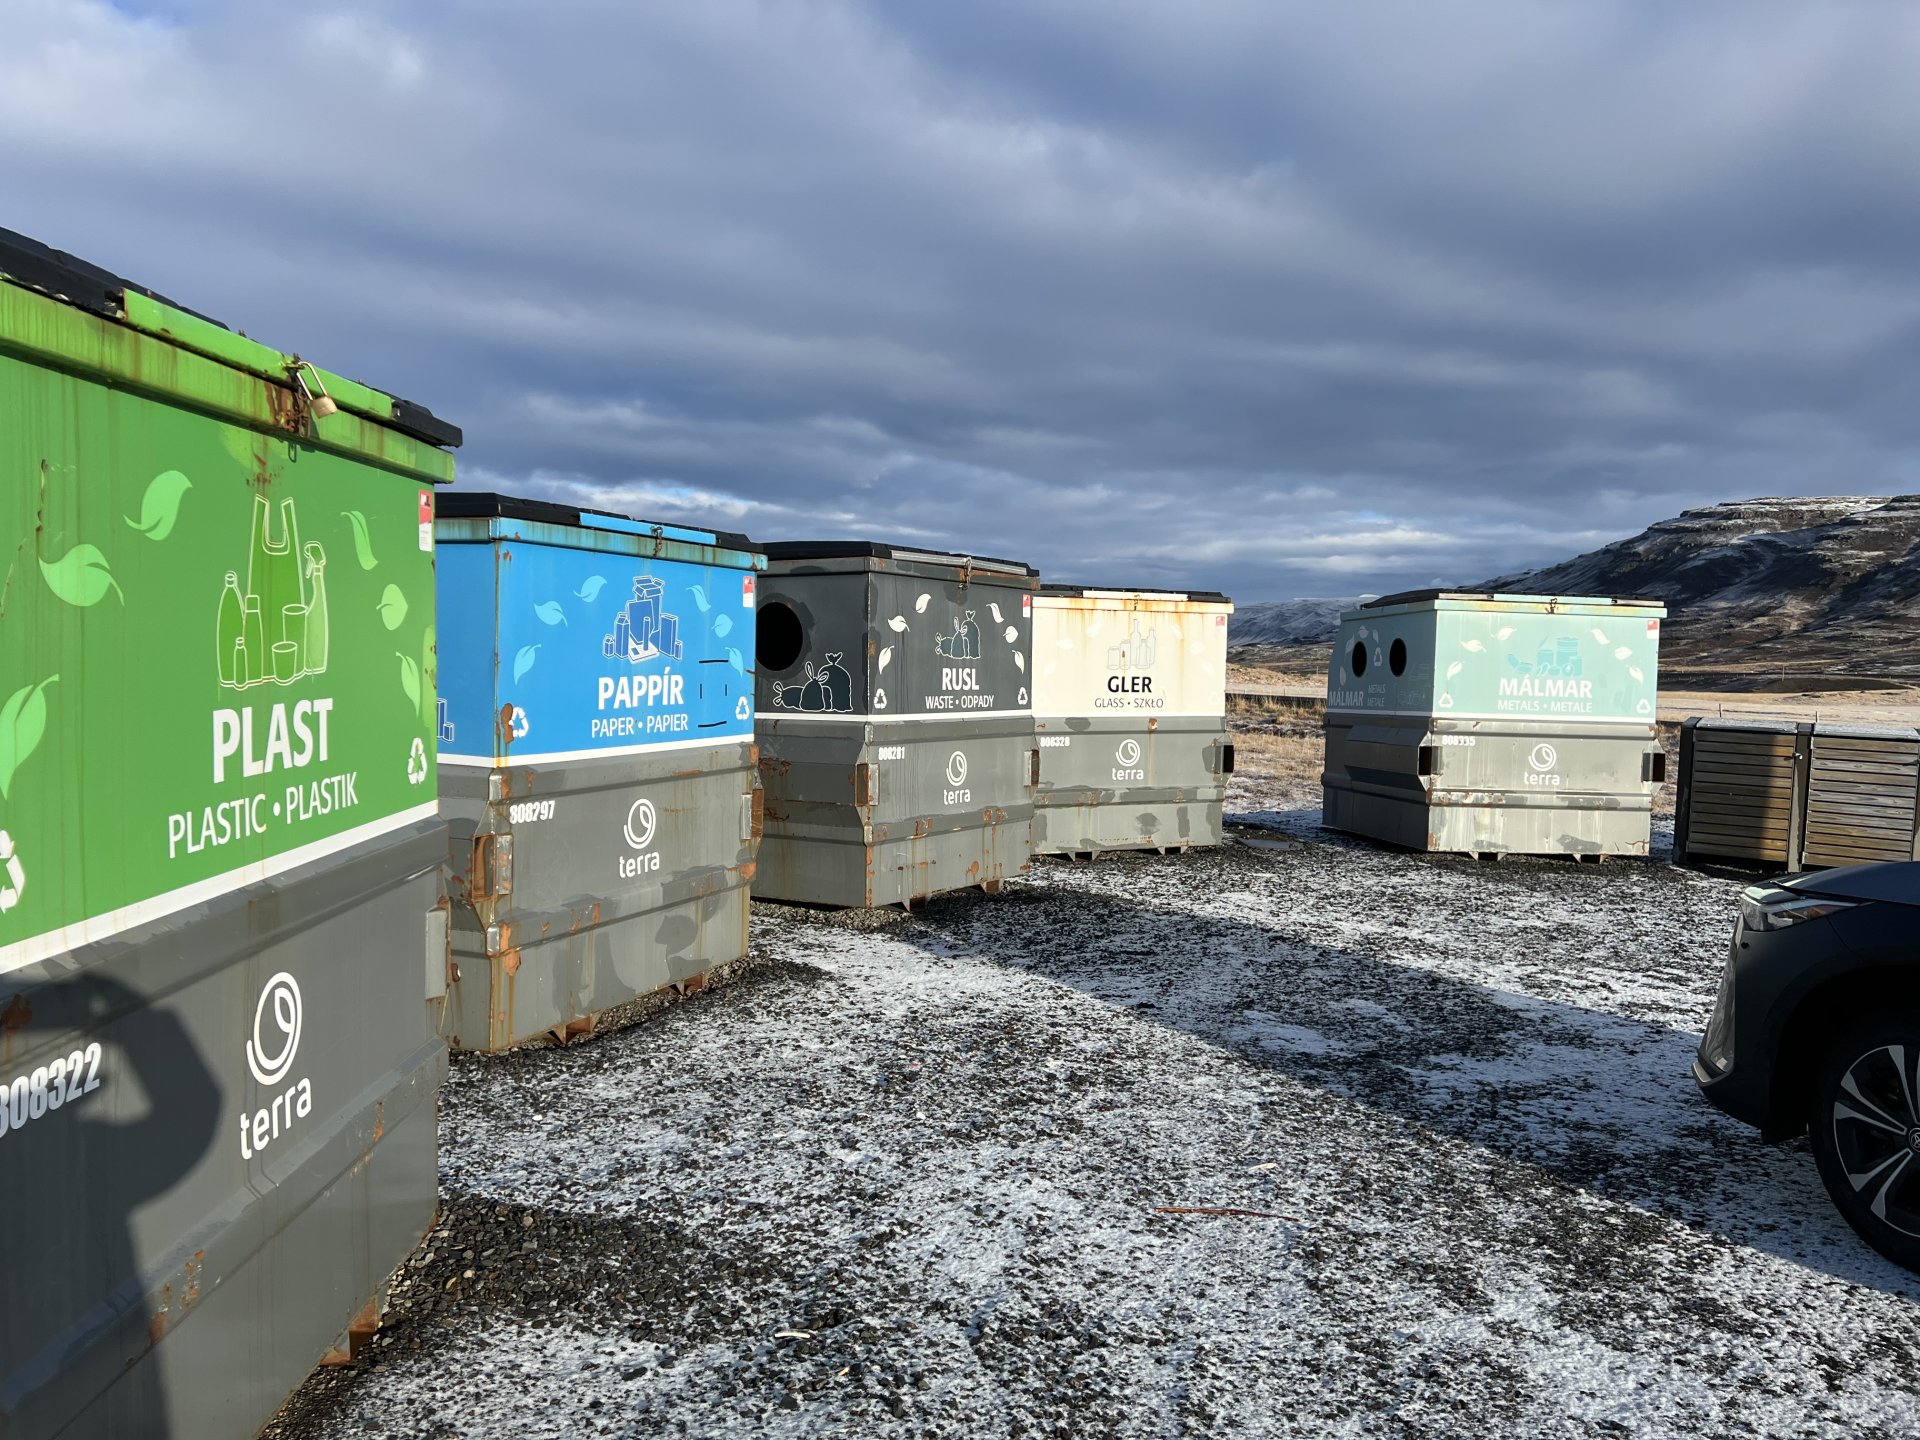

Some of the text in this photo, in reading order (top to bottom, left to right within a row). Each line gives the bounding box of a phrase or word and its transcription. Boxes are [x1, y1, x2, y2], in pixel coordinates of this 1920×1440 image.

[599, 666, 684, 710] PAPPÍR
[942, 667, 979, 691] RUSL
[1107, 675, 1152, 693] GLER
[1499, 674, 1593, 698] MÁLMAR
[925, 694, 994, 709] WASTE ODPADY
[1094, 697, 1164, 709] GLASS SZKŁO
[1328, 687, 1364, 707] MÁLMAR
[1497, 699, 1593, 713] METALS METALE
[591, 713, 689, 738] PAPER PAPIER
[213, 697, 333, 783] PLAST
[1111, 767, 1144, 780] terra
[1523, 771, 1560, 786] terra
[943, 787, 971, 805] terra
[169, 771, 359, 858] PLASTIC PLASTIK
[509, 800, 555, 824] 808297
[619, 851, 660, 879] terra
[240, 1077, 312, 1160] terra
